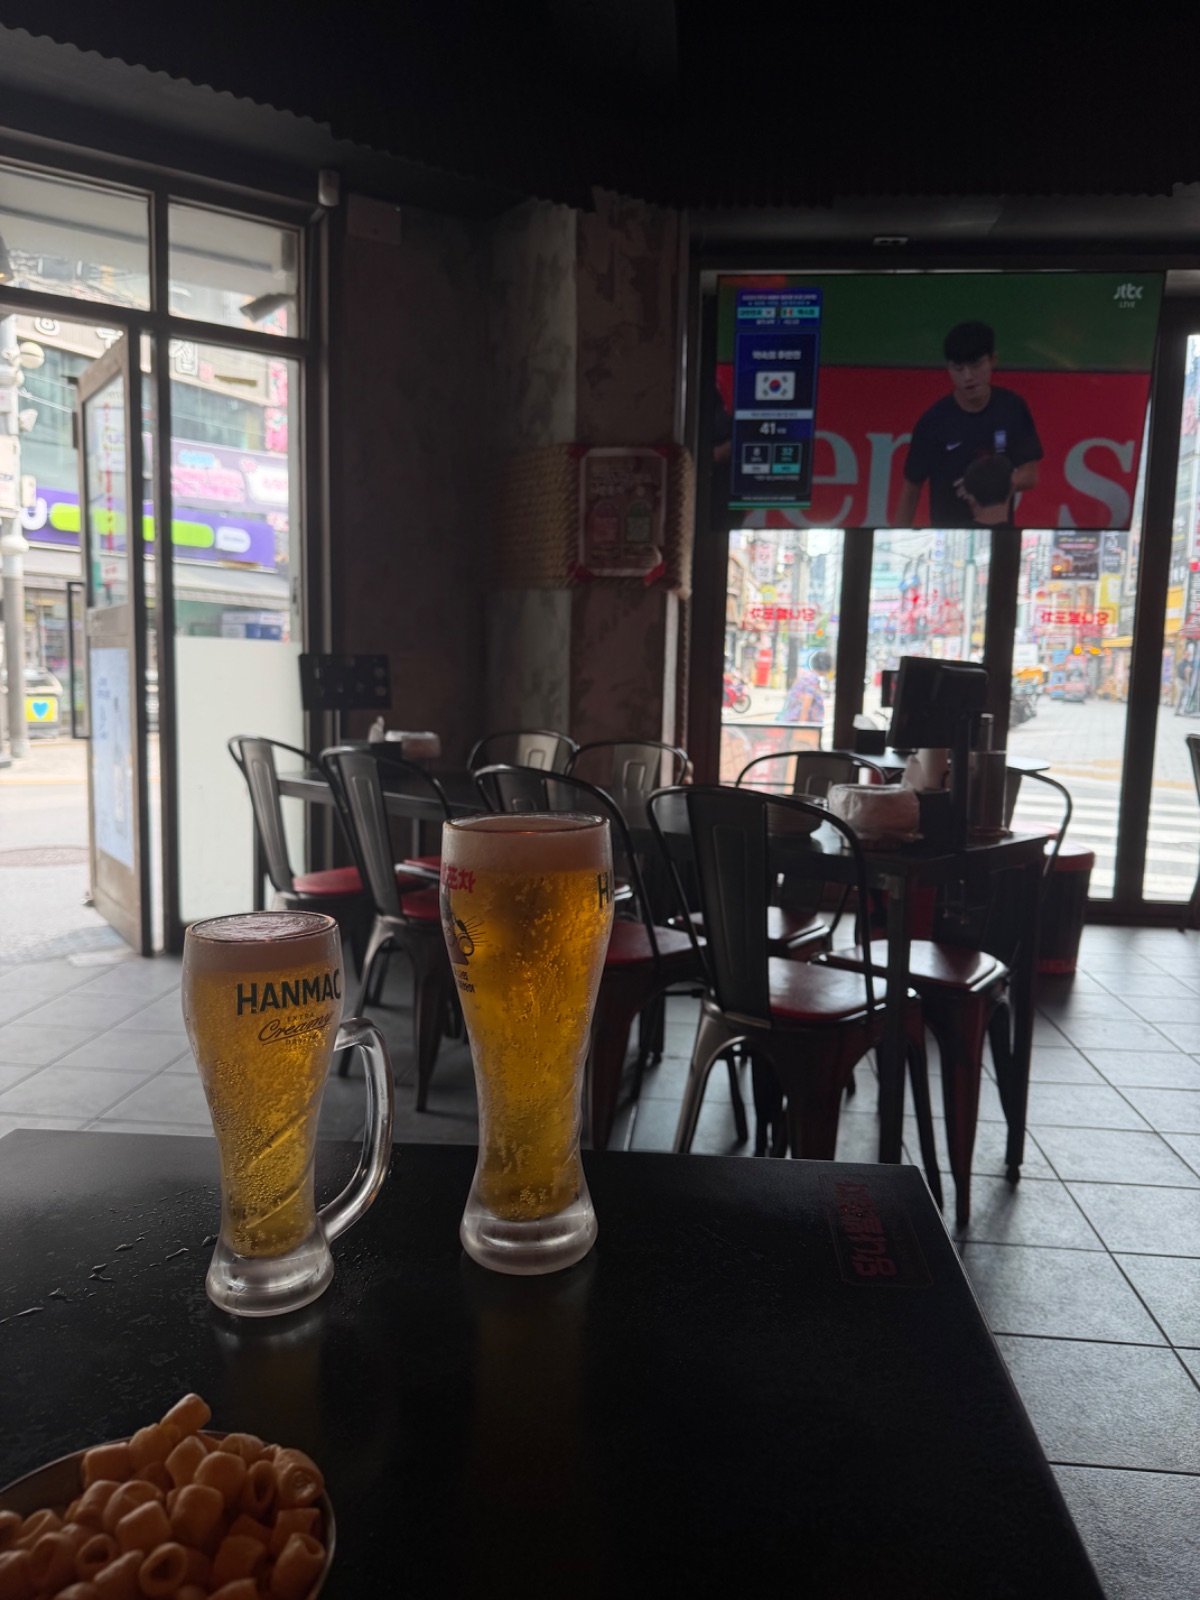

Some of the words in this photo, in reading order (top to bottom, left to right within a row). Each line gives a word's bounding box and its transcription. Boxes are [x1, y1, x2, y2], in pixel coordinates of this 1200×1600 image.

[759, 422, 776, 435] 41
[236, 968, 342, 1016] HANMAC
[258, 1011, 334, 1044] Creamy
[286, 1012, 315, 1022] EXTRA
